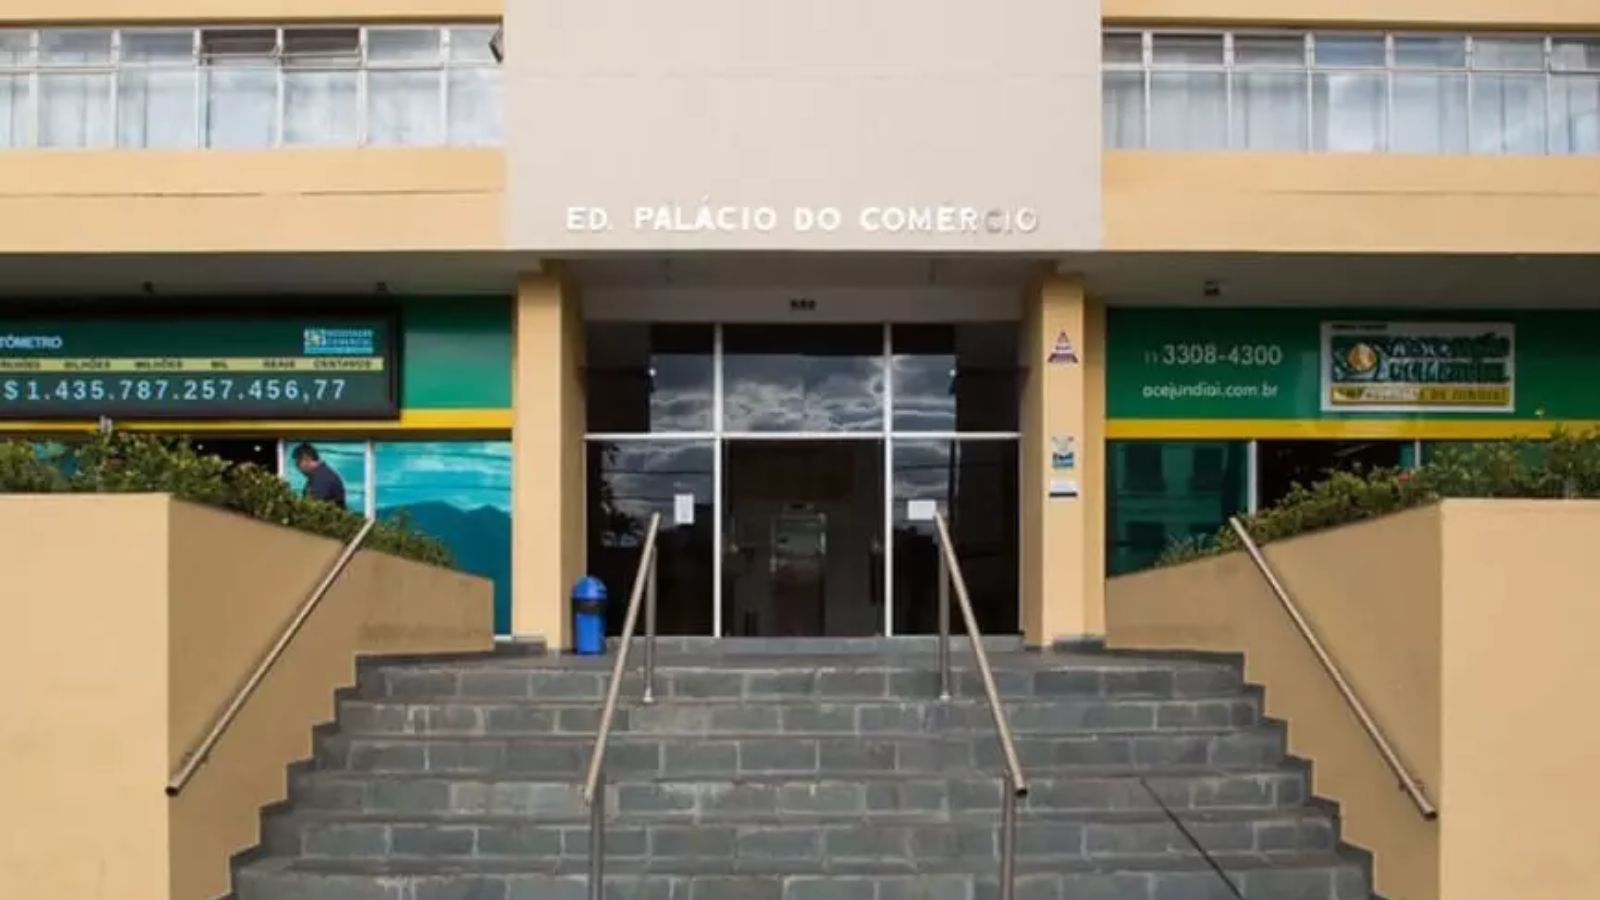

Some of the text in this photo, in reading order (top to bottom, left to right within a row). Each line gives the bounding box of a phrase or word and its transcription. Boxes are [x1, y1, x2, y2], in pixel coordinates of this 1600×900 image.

[565, 206, 614, 231] ED.
[633, 194, 778, 231] PALÁCIO
[794, 206, 842, 231] DO
[1162, 343, 1282, 365] 3308-4300
